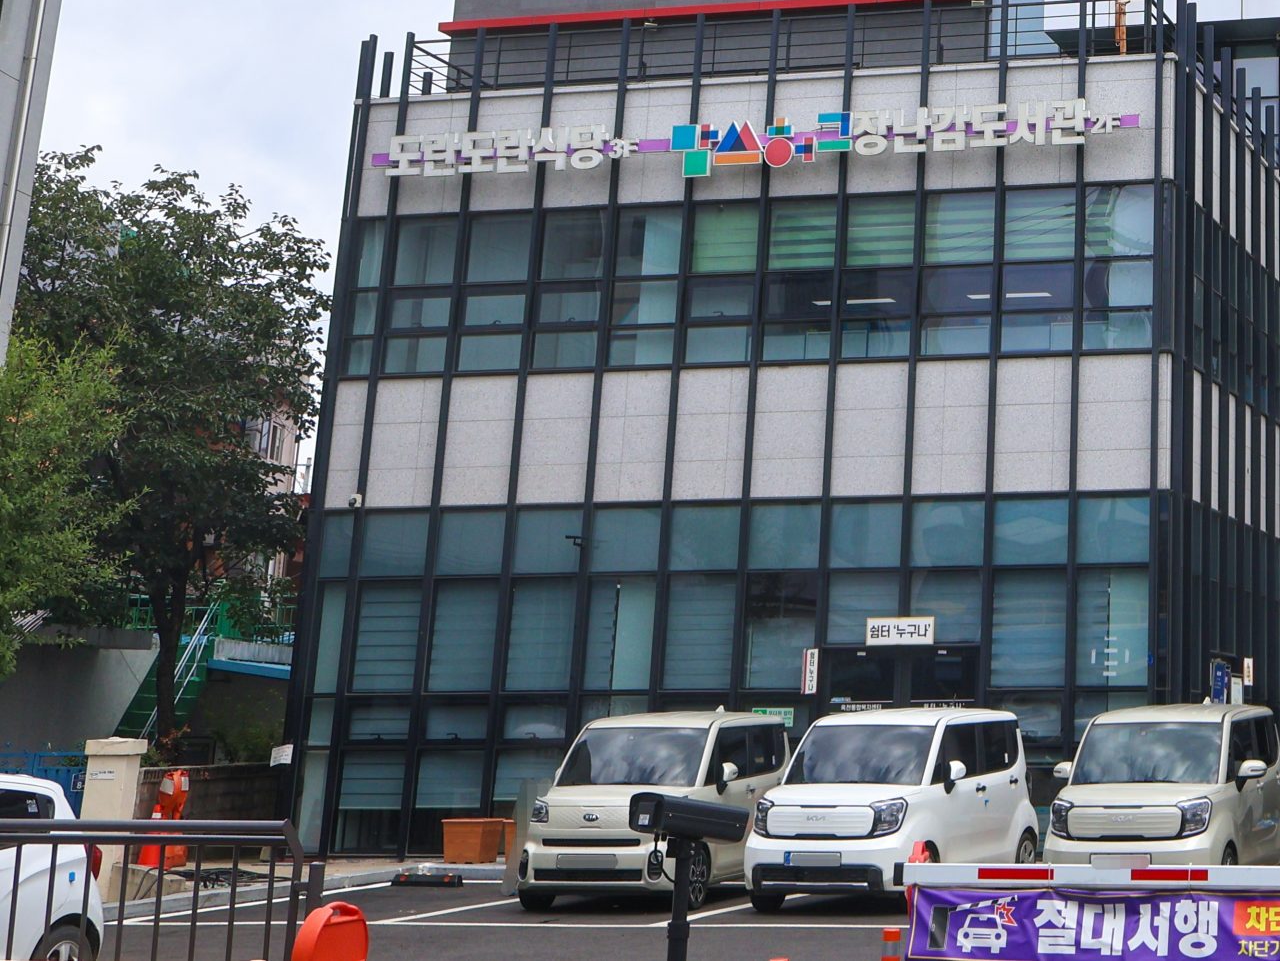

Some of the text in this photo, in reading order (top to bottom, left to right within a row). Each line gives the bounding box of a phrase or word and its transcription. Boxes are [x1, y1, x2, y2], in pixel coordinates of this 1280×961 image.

[385, 124, 639, 177] 도란도란식당 3F
[853, 98, 1121, 156] 장난감도서관 2F
[869, 625, 890, 638] 쉼터
[1033, 899, 1219, 958] 절대서행
